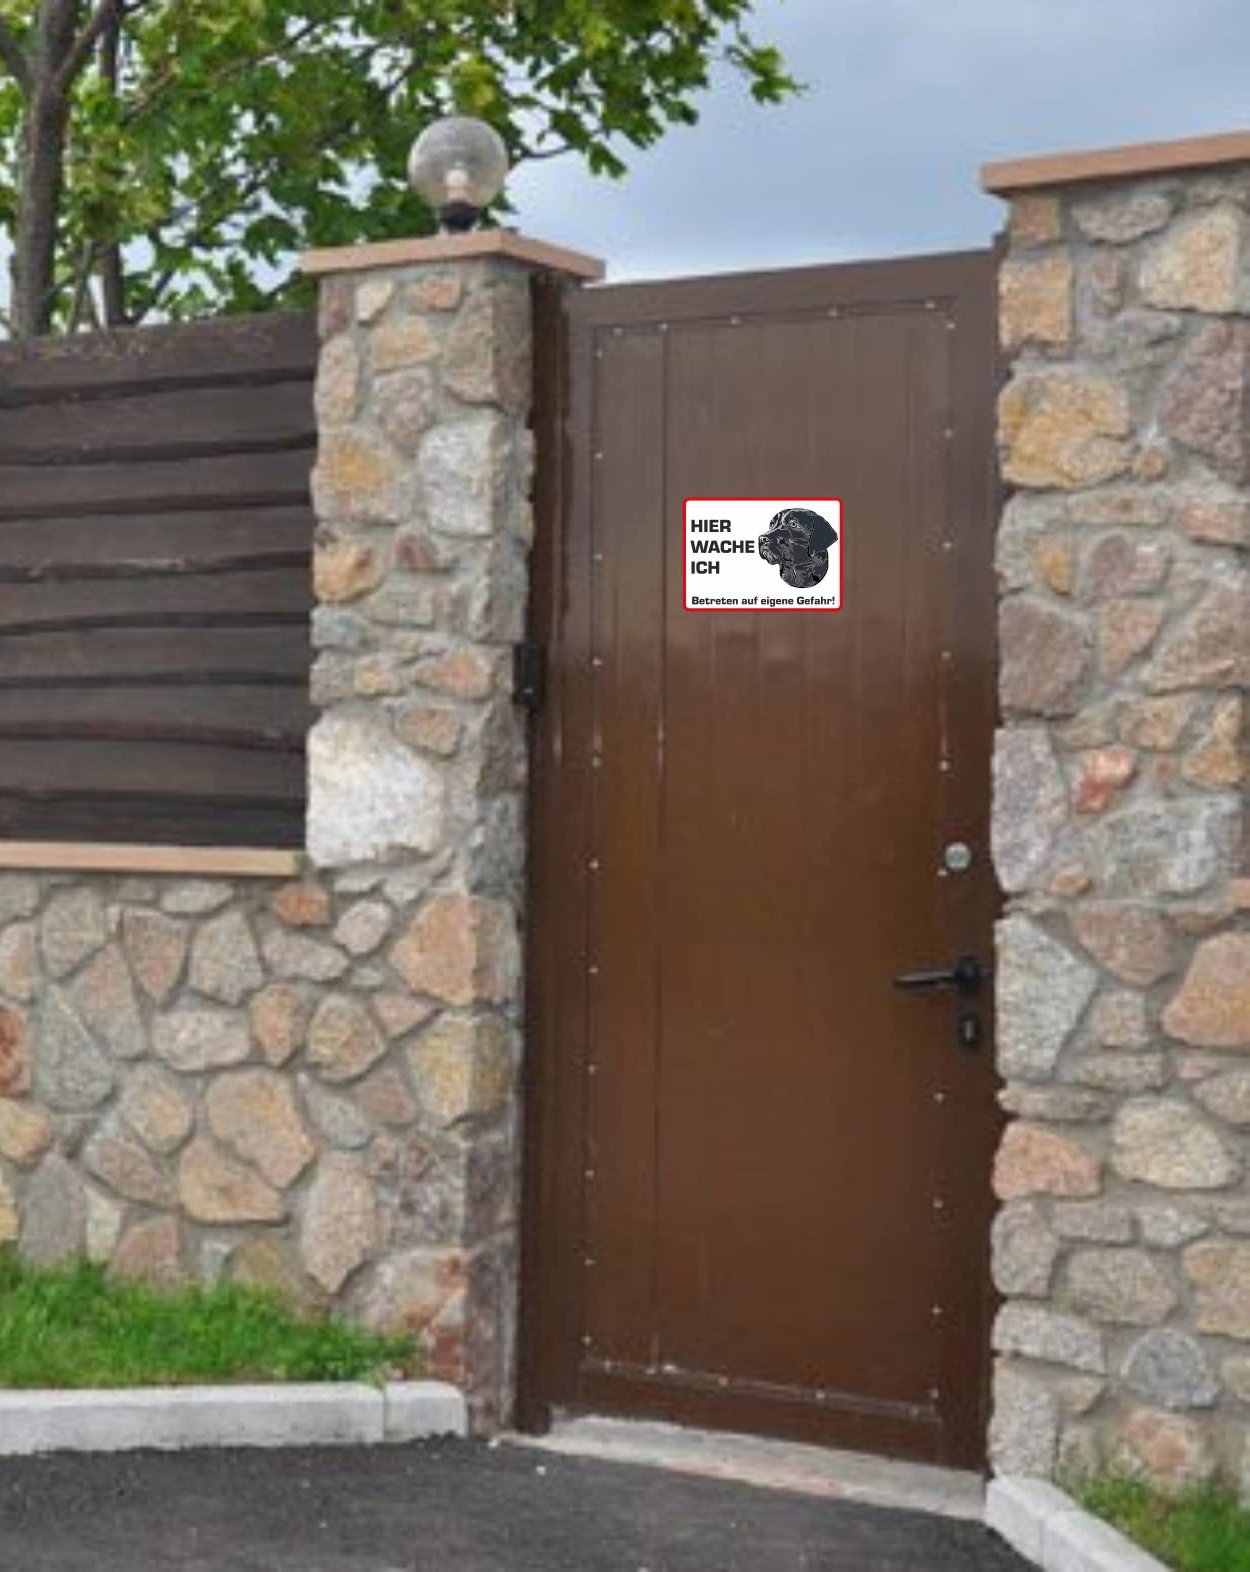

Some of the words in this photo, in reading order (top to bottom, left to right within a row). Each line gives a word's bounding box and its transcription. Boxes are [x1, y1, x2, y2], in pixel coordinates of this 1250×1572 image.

[691, 520, 731, 532] HIER
[691, 540, 755, 553] WACHE
[691, 561, 719, 574] ICH
[692, 597, 738, 605] Betreten
[742, 596, 758, 605] auf
[761, 597, 793, 607] eigene
[797, 596, 835, 605] Gefahr!
